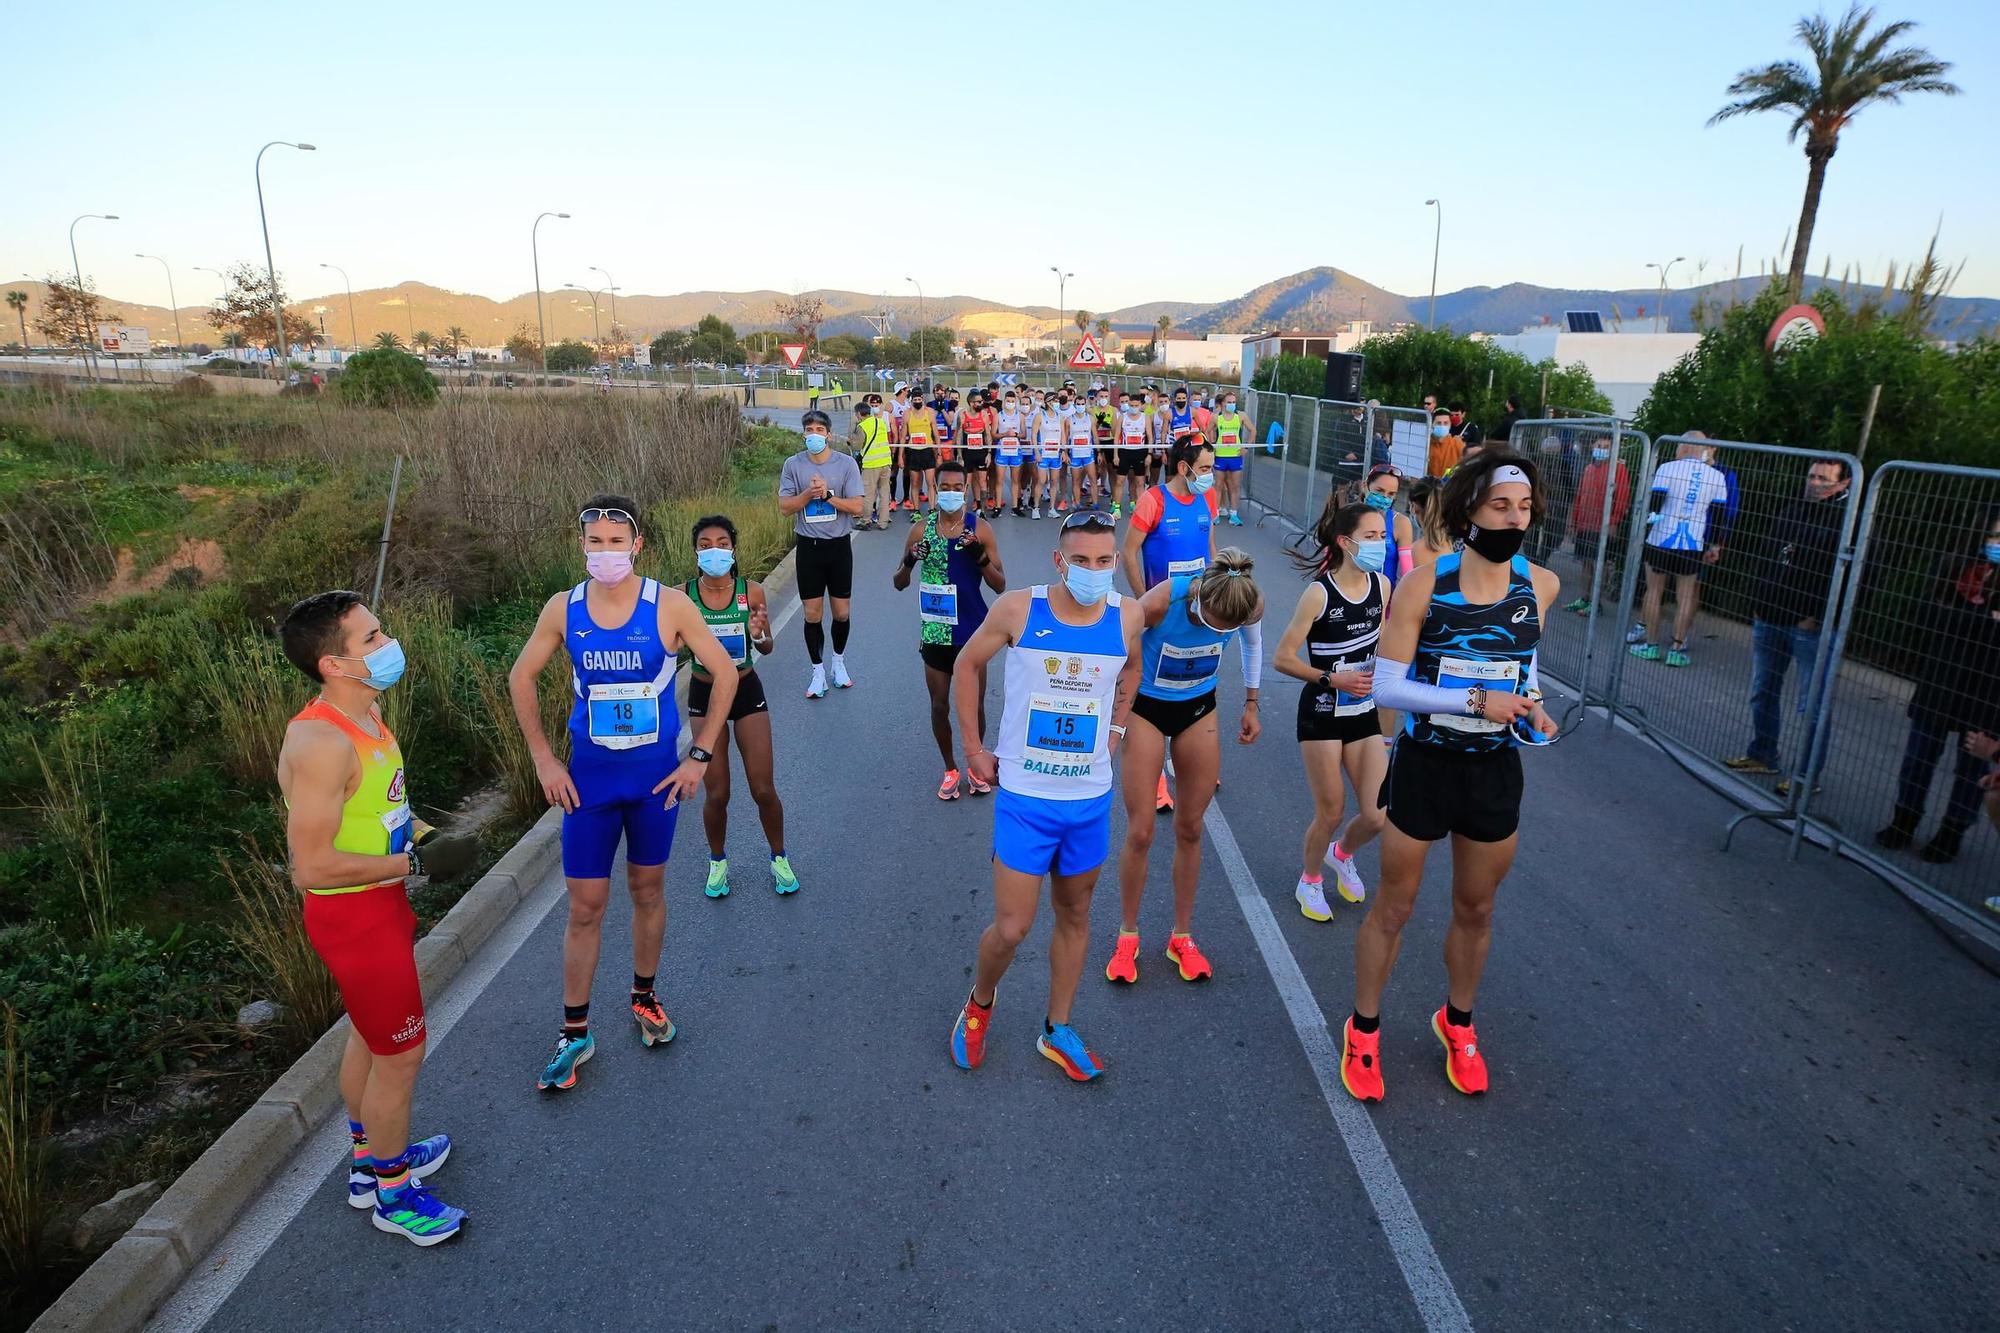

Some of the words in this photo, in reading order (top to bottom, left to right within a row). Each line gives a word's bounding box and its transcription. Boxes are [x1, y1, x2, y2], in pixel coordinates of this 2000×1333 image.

[1347, 623, 1366, 631] SUPER
[582, 650, 643, 671] GANDIA
[1185, 660, 1194, 671] 8
[1064, 680, 1093, 688] DEPORTIVA
[613, 703, 633, 720] 18
[1055, 716, 1075, 735] 15
[1023, 759, 1091, 777] BALEARIA
